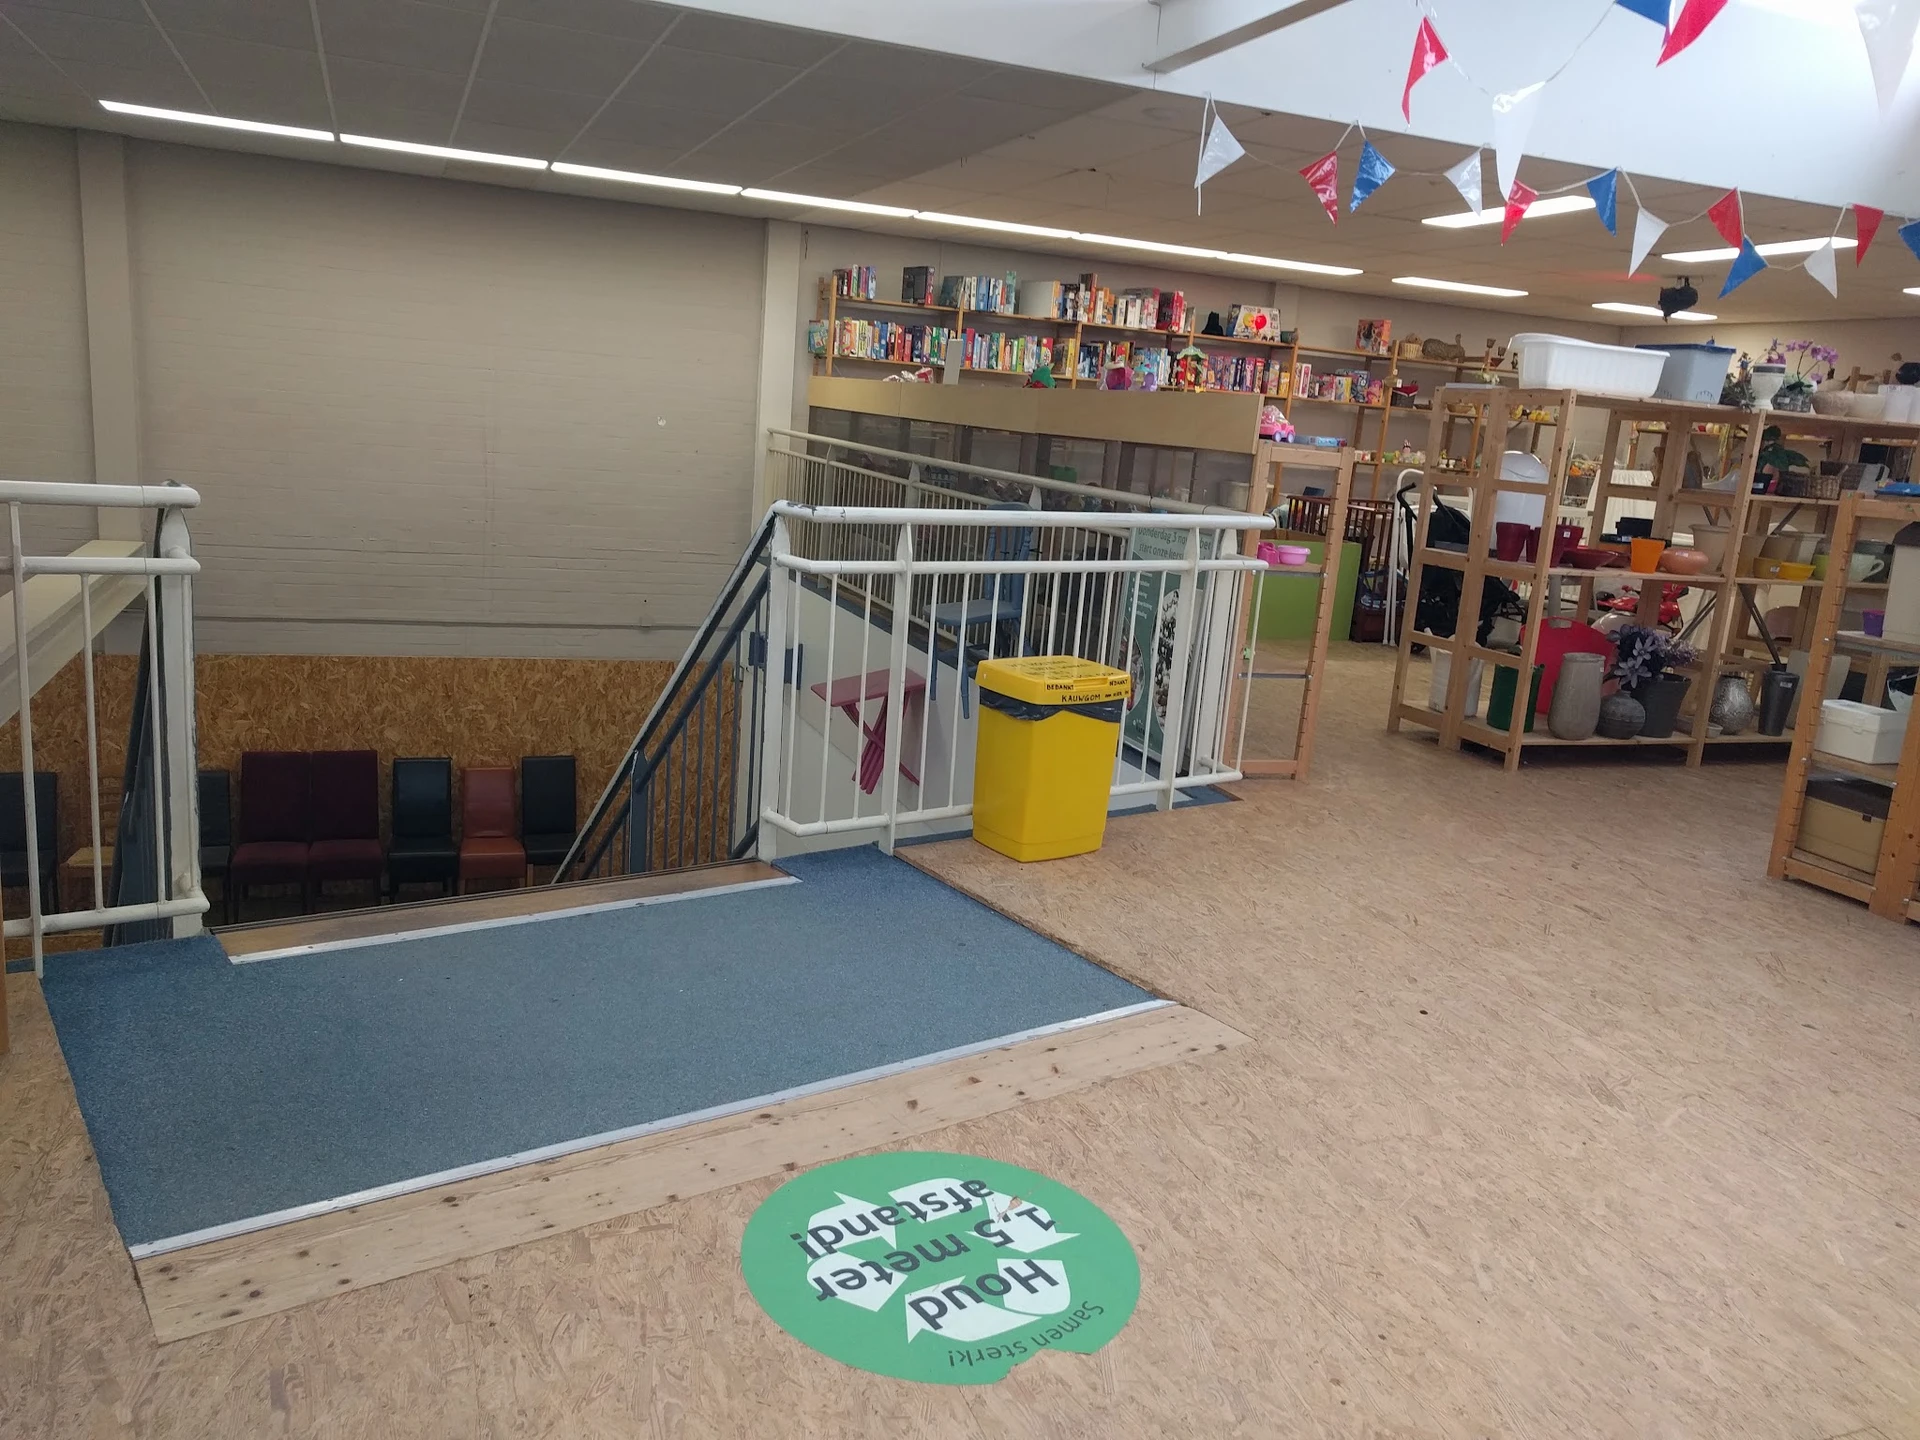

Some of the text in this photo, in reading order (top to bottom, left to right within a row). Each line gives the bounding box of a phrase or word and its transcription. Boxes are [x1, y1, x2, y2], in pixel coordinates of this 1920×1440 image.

[1139, 543, 1152, 553] start
[1152, 547, 1168, 558] onze
[1171, 532, 1177, 542] 3
[1062, 694, 1101, 703] KAUWGOM
[790, 1179, 994, 1260] afstand!
[812, 1206, 1056, 1302] 1,5 meter
[908, 1259, 1059, 1331] Houd
[948, 1301, 1104, 1367] Samen sterk!
